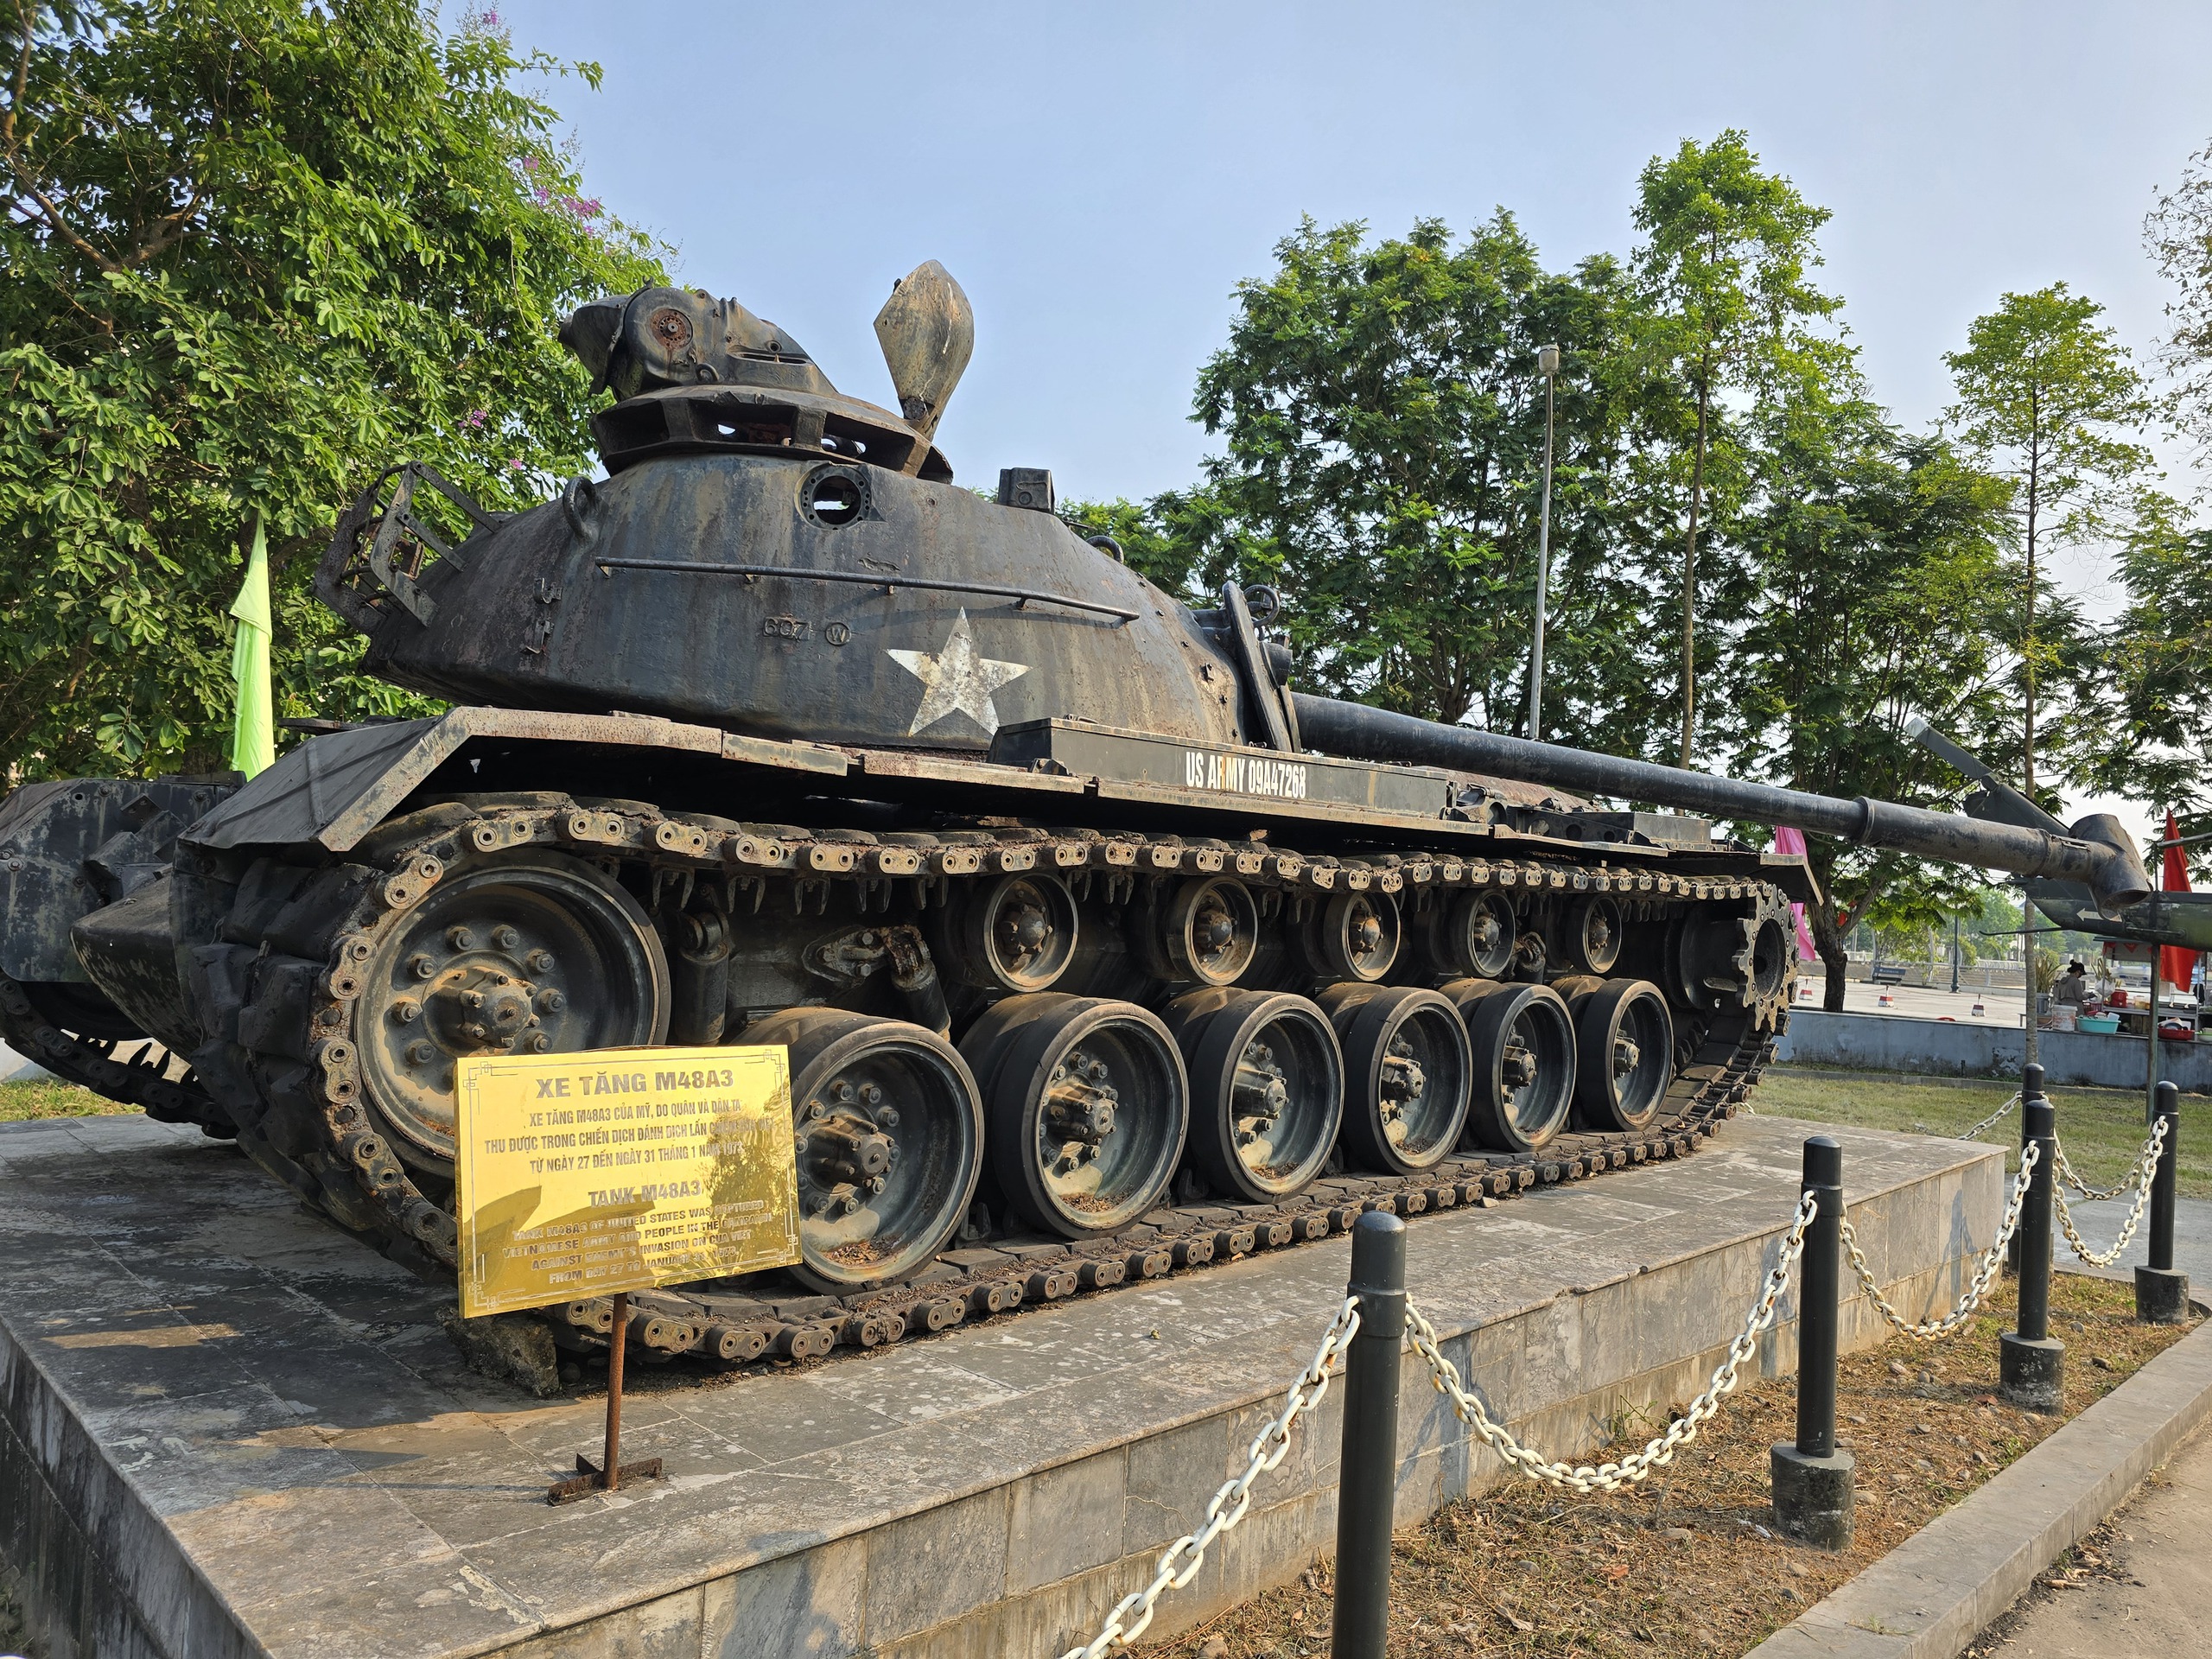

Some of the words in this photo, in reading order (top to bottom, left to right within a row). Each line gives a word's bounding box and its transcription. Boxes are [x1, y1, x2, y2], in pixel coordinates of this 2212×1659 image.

[1185, 752, 1205, 788] US
[1207, 754, 1245, 793] ARMY
[1248, 760, 1306, 798] 09A47268
[536, 1077, 571, 1099] XE
[579, 1071, 646, 1096] TĂNG
[655, 1069, 734, 1091] M48A3
[529, 1113, 543, 1127] XE
[546, 1109, 574, 1125] TĂNG
[577, 1108, 611, 1123] M48A3
[613, 1103, 633, 1120] CỦA
[636, 1103, 654, 1119] MỸ,
[656, 1103, 669, 1117] DO
[671, 1099, 696, 1116] QUÂN
[698, 1098, 709, 1114] VÀ
[731, 1098, 741, 1111] TA
[485, 1139, 506, 1154] THU
[509, 1135, 537, 1154] ĐƯỢC
[541, 1135, 576, 1149] TRONG
[579, 1127, 608, 1146] CHIẾN
[612, 1128, 635, 1146] DỊCH
[638, 1123, 664, 1141] ĐÁNH
[690, 1119, 707, 1137] LẤN
[530, 1156, 544, 1174] TỪ
[546, 1154, 575, 1173] NGÀY
[577, 1155, 590, 1170] 27
[592, 1149, 613, 1168] ĐẾN
[615, 1147, 641, 1165] NGÀY
[644, 1149, 655, 1163] 31
[658, 1144, 689, 1161] THÁNG
[691, 1146, 696, 1158] 1
[588, 1185, 636, 1208] TANK
[641, 1180, 702, 1203] M48A3
[503, 1239, 579, 1259] VIETNAMESE
[582, 1234, 615, 1249] ARMY
[619, 1230, 642, 1243] AND
[645, 1225, 684, 1239] PEOPLE
[687, 1223, 699, 1233] IN
[702, 1219, 719, 1232] THE
[512, 1227, 544, 1242] TANK
[546, 1223, 588, 1238] M48A3
[589, 1222, 604, 1232] OF
[650, 1210, 686, 1224] STATES
[690, 1206, 712, 1218] WAS
[531, 1255, 582, 1271] AGAINST
[639, 1239, 690, 1255] INVASION
[693, 1236, 707, 1247] ON
[709, 1232, 728, 1244] CUA
[731, 1230, 752, 1241] VIET
[549, 1269, 582, 1284] FROM
[586, 1267, 607, 1279] DAY
[610, 1263, 624, 1275] 27
[627, 1261, 641, 1272] TO
